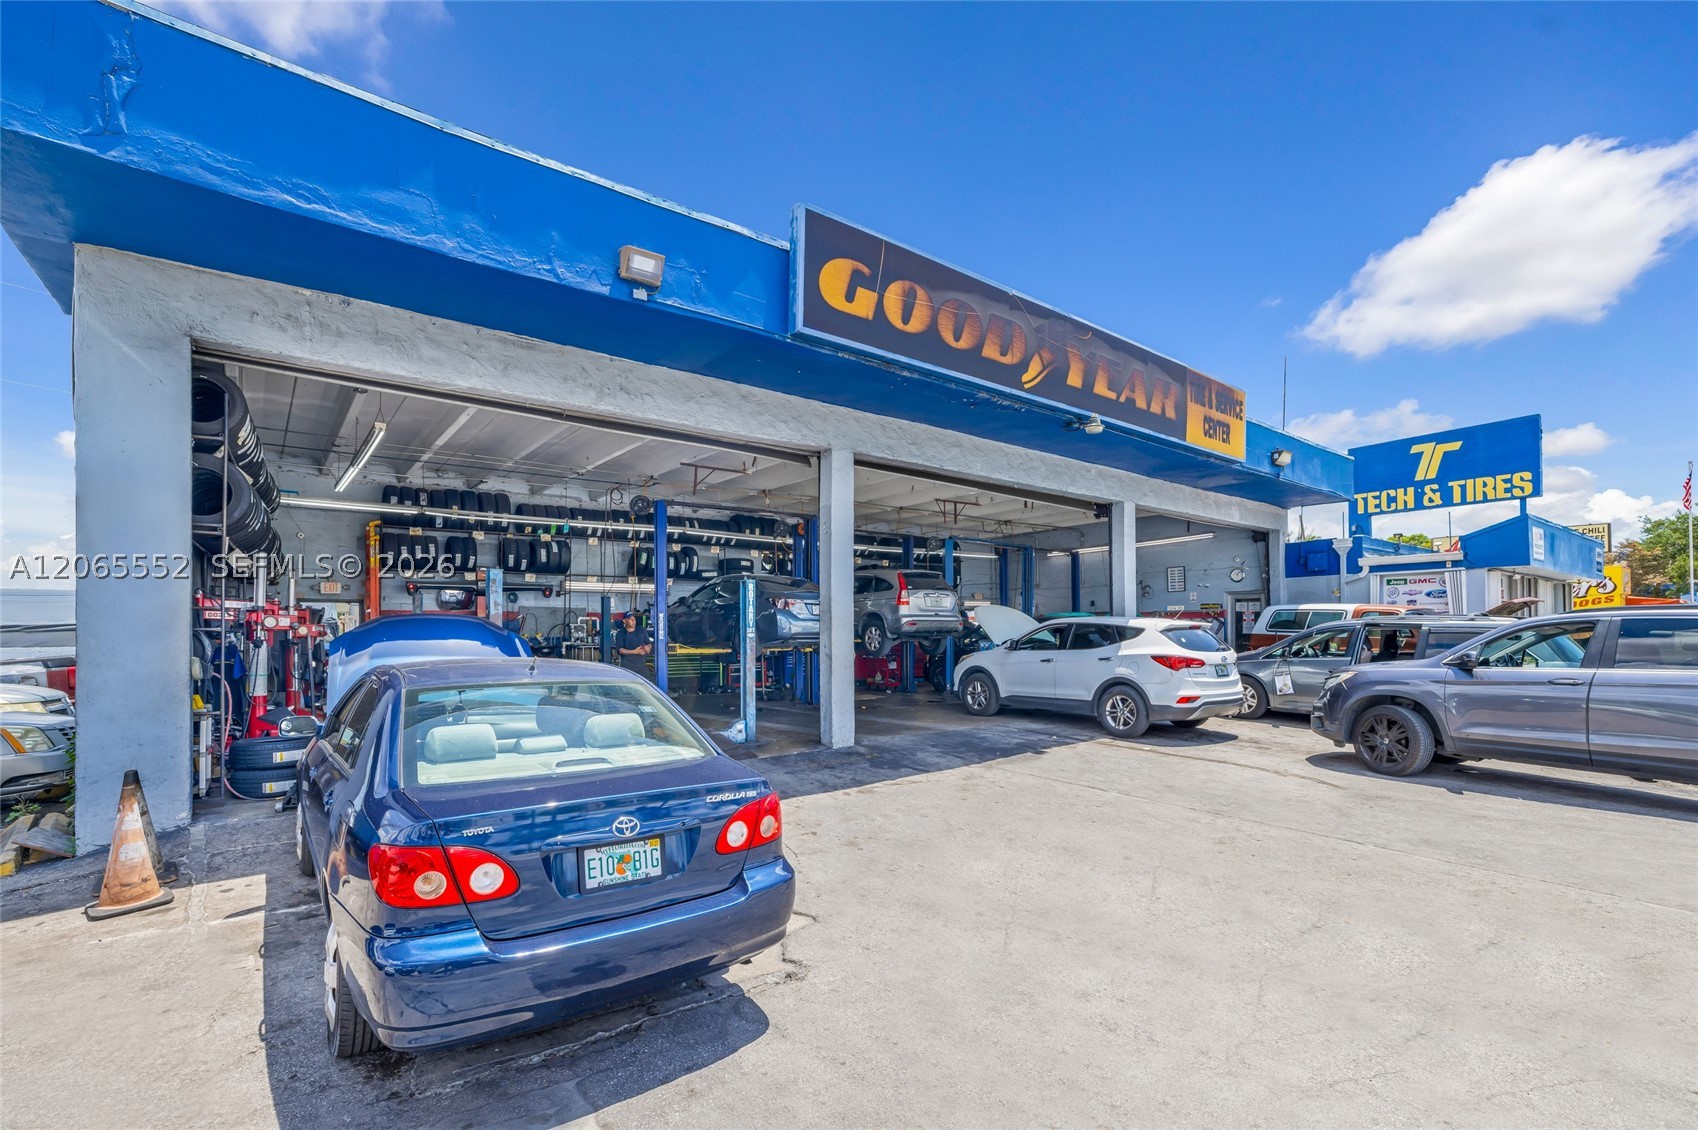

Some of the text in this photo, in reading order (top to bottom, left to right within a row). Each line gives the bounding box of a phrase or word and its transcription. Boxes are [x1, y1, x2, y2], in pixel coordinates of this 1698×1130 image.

[818, 257, 1179, 421] GOODYEAR
[1215, 391, 1243, 421] SERVICE
[1203, 414, 1231, 445] CENTER
[1353, 471, 1534, 515] TECH & TIRES
[1582, 526, 1605, 535] CHILI
[323, 583, 338, 593] EXIT
[706, 792, 746, 803] COROLLA
[462, 826, 494, 837] TOYOTA
[587, 855, 615, 880] E10
[602, 875, 629, 886] SUNSHINE
